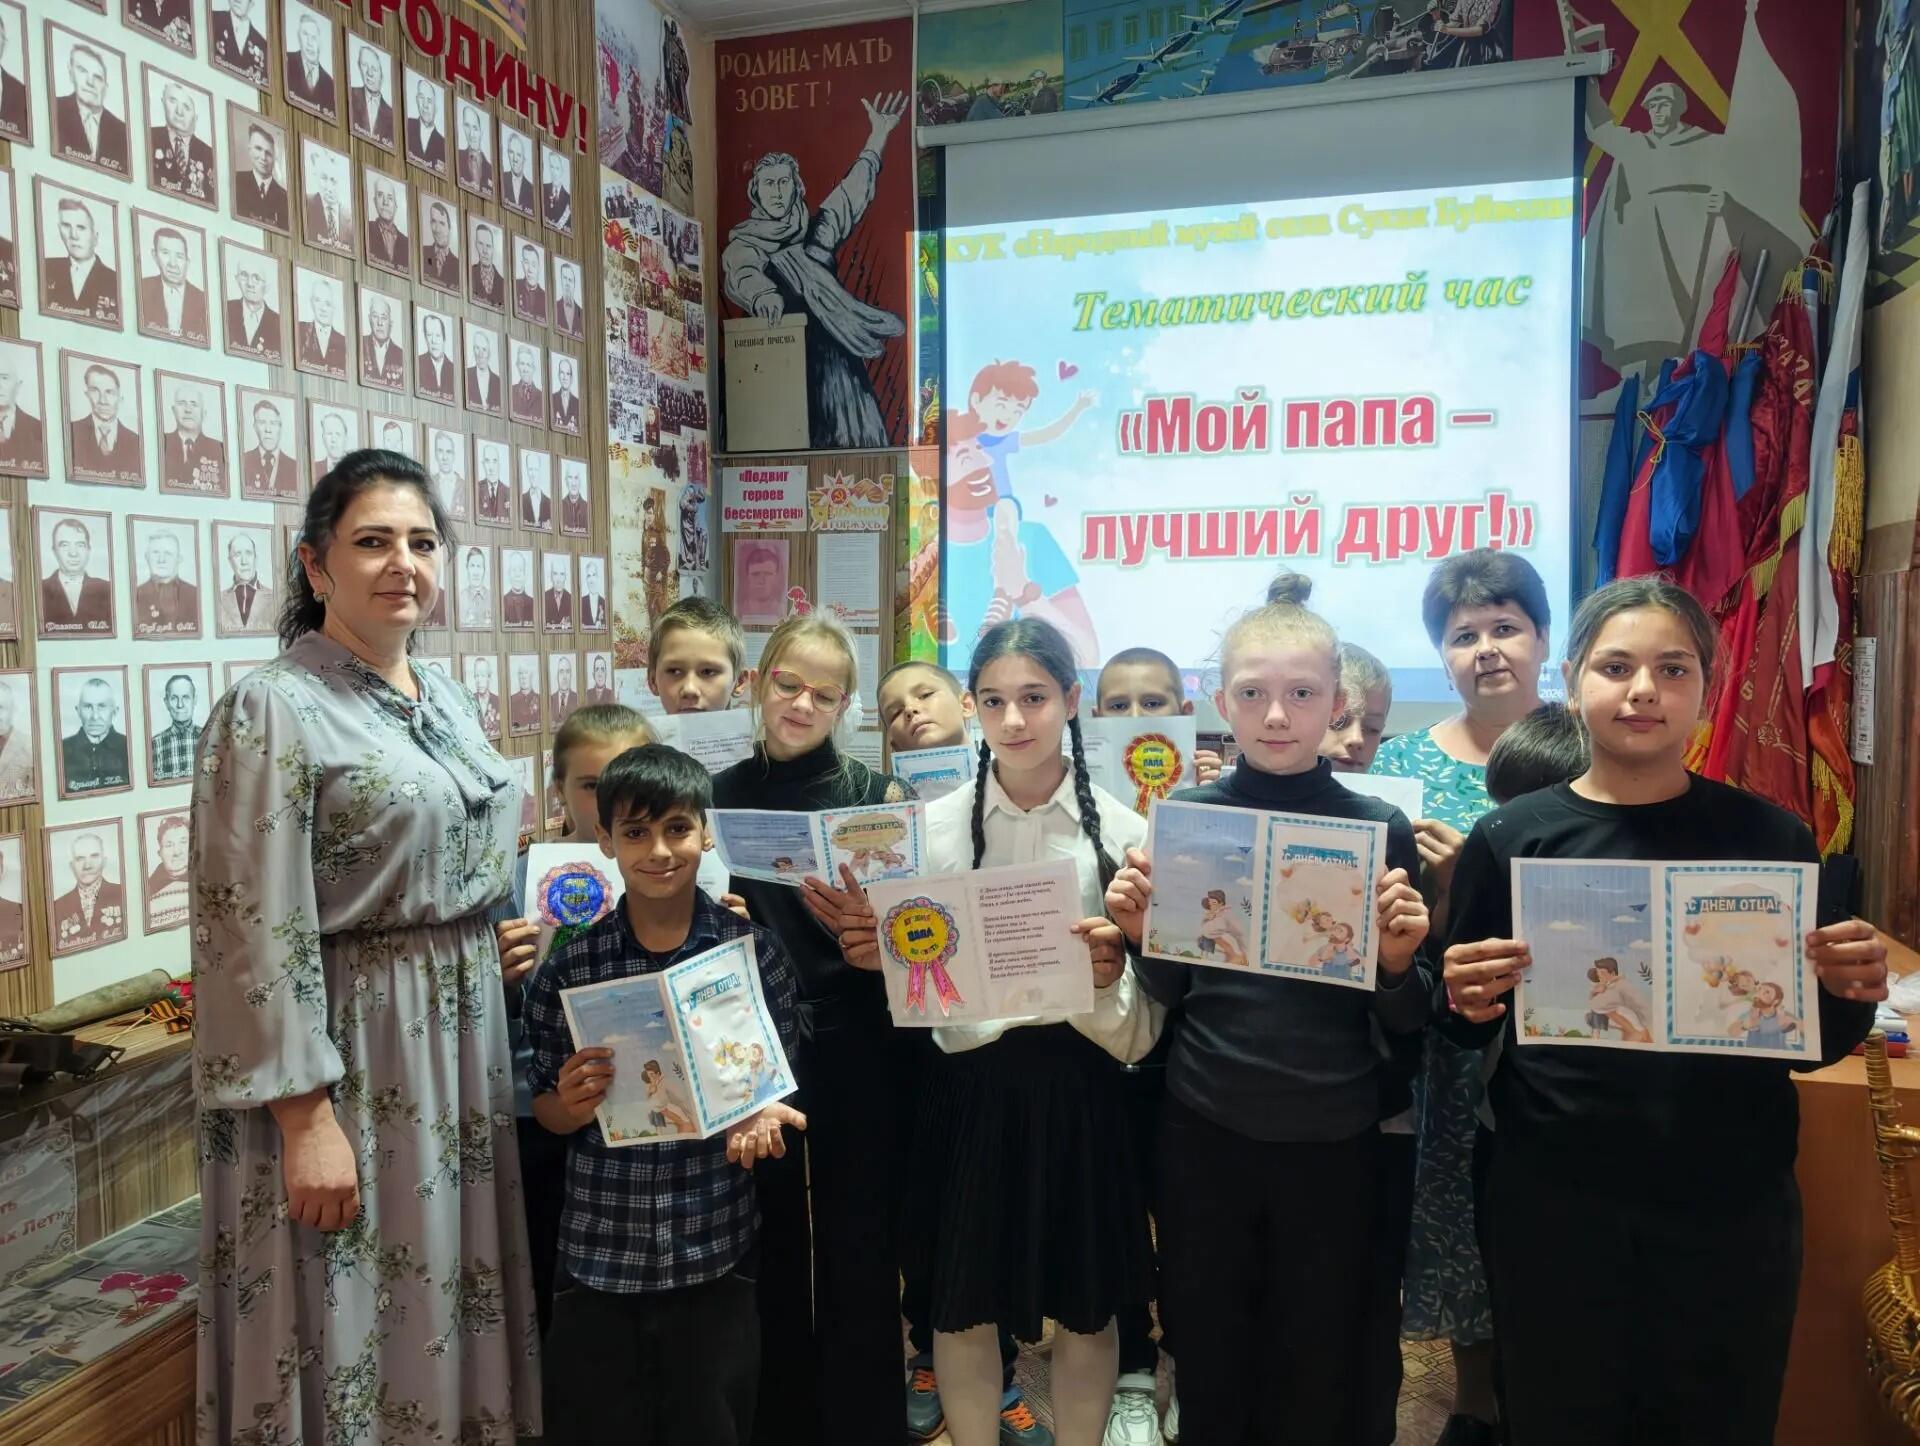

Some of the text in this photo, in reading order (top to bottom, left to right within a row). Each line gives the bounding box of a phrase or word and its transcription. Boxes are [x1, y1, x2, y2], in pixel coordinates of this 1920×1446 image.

[719, 37, 893, 79] РОДИНА-МАТЬ
[1072, 271, 1534, 332] Тематический час
[1119, 390, 1269, 456] «Мой
[1284, 395, 1437, 450] папа
[739, 470, 790, 483] «Подвиг
[743, 489, 784, 502] героев
[724, 507, 803, 520] бессмертен»
[1080, 493, 1534, 566] лучший друг!»
